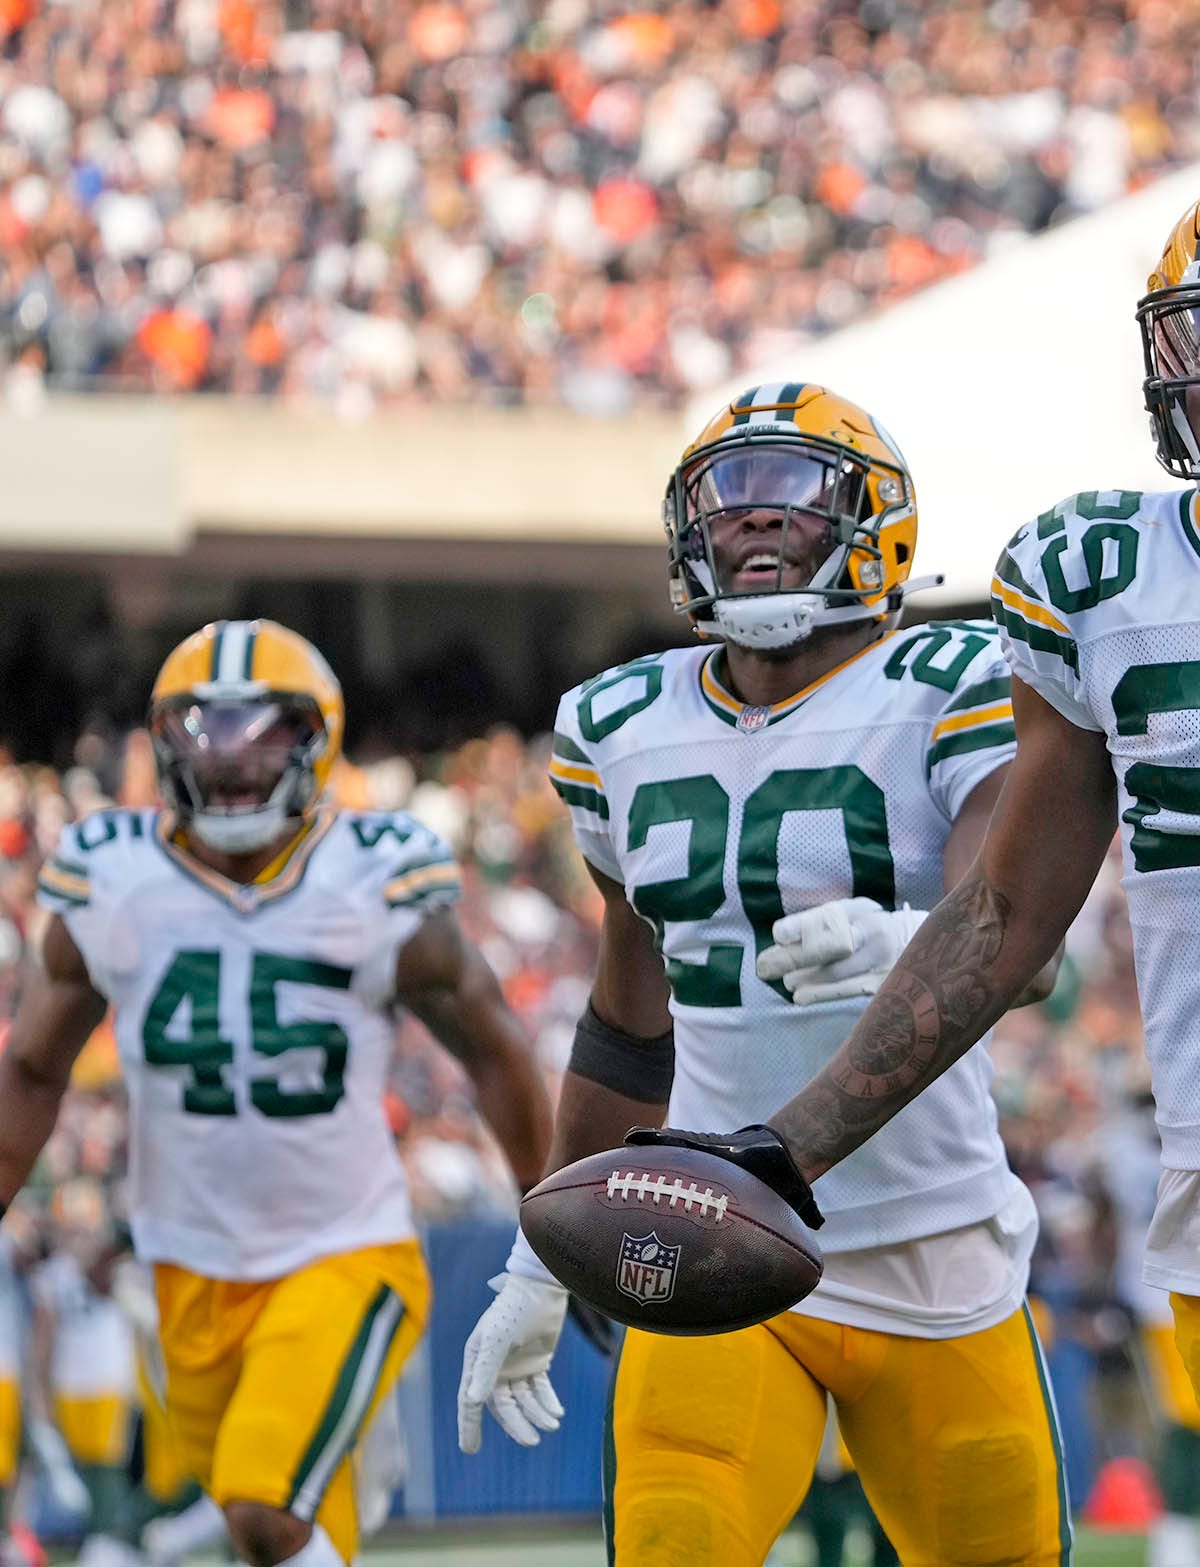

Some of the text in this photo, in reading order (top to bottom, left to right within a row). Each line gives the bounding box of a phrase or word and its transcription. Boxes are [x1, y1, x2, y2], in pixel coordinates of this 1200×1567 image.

[741, 712, 765, 728] NFL
[627, 764, 896, 1007] 20
[143, 946, 353, 1117] 45
[623, 1261, 668, 1297] NFL
